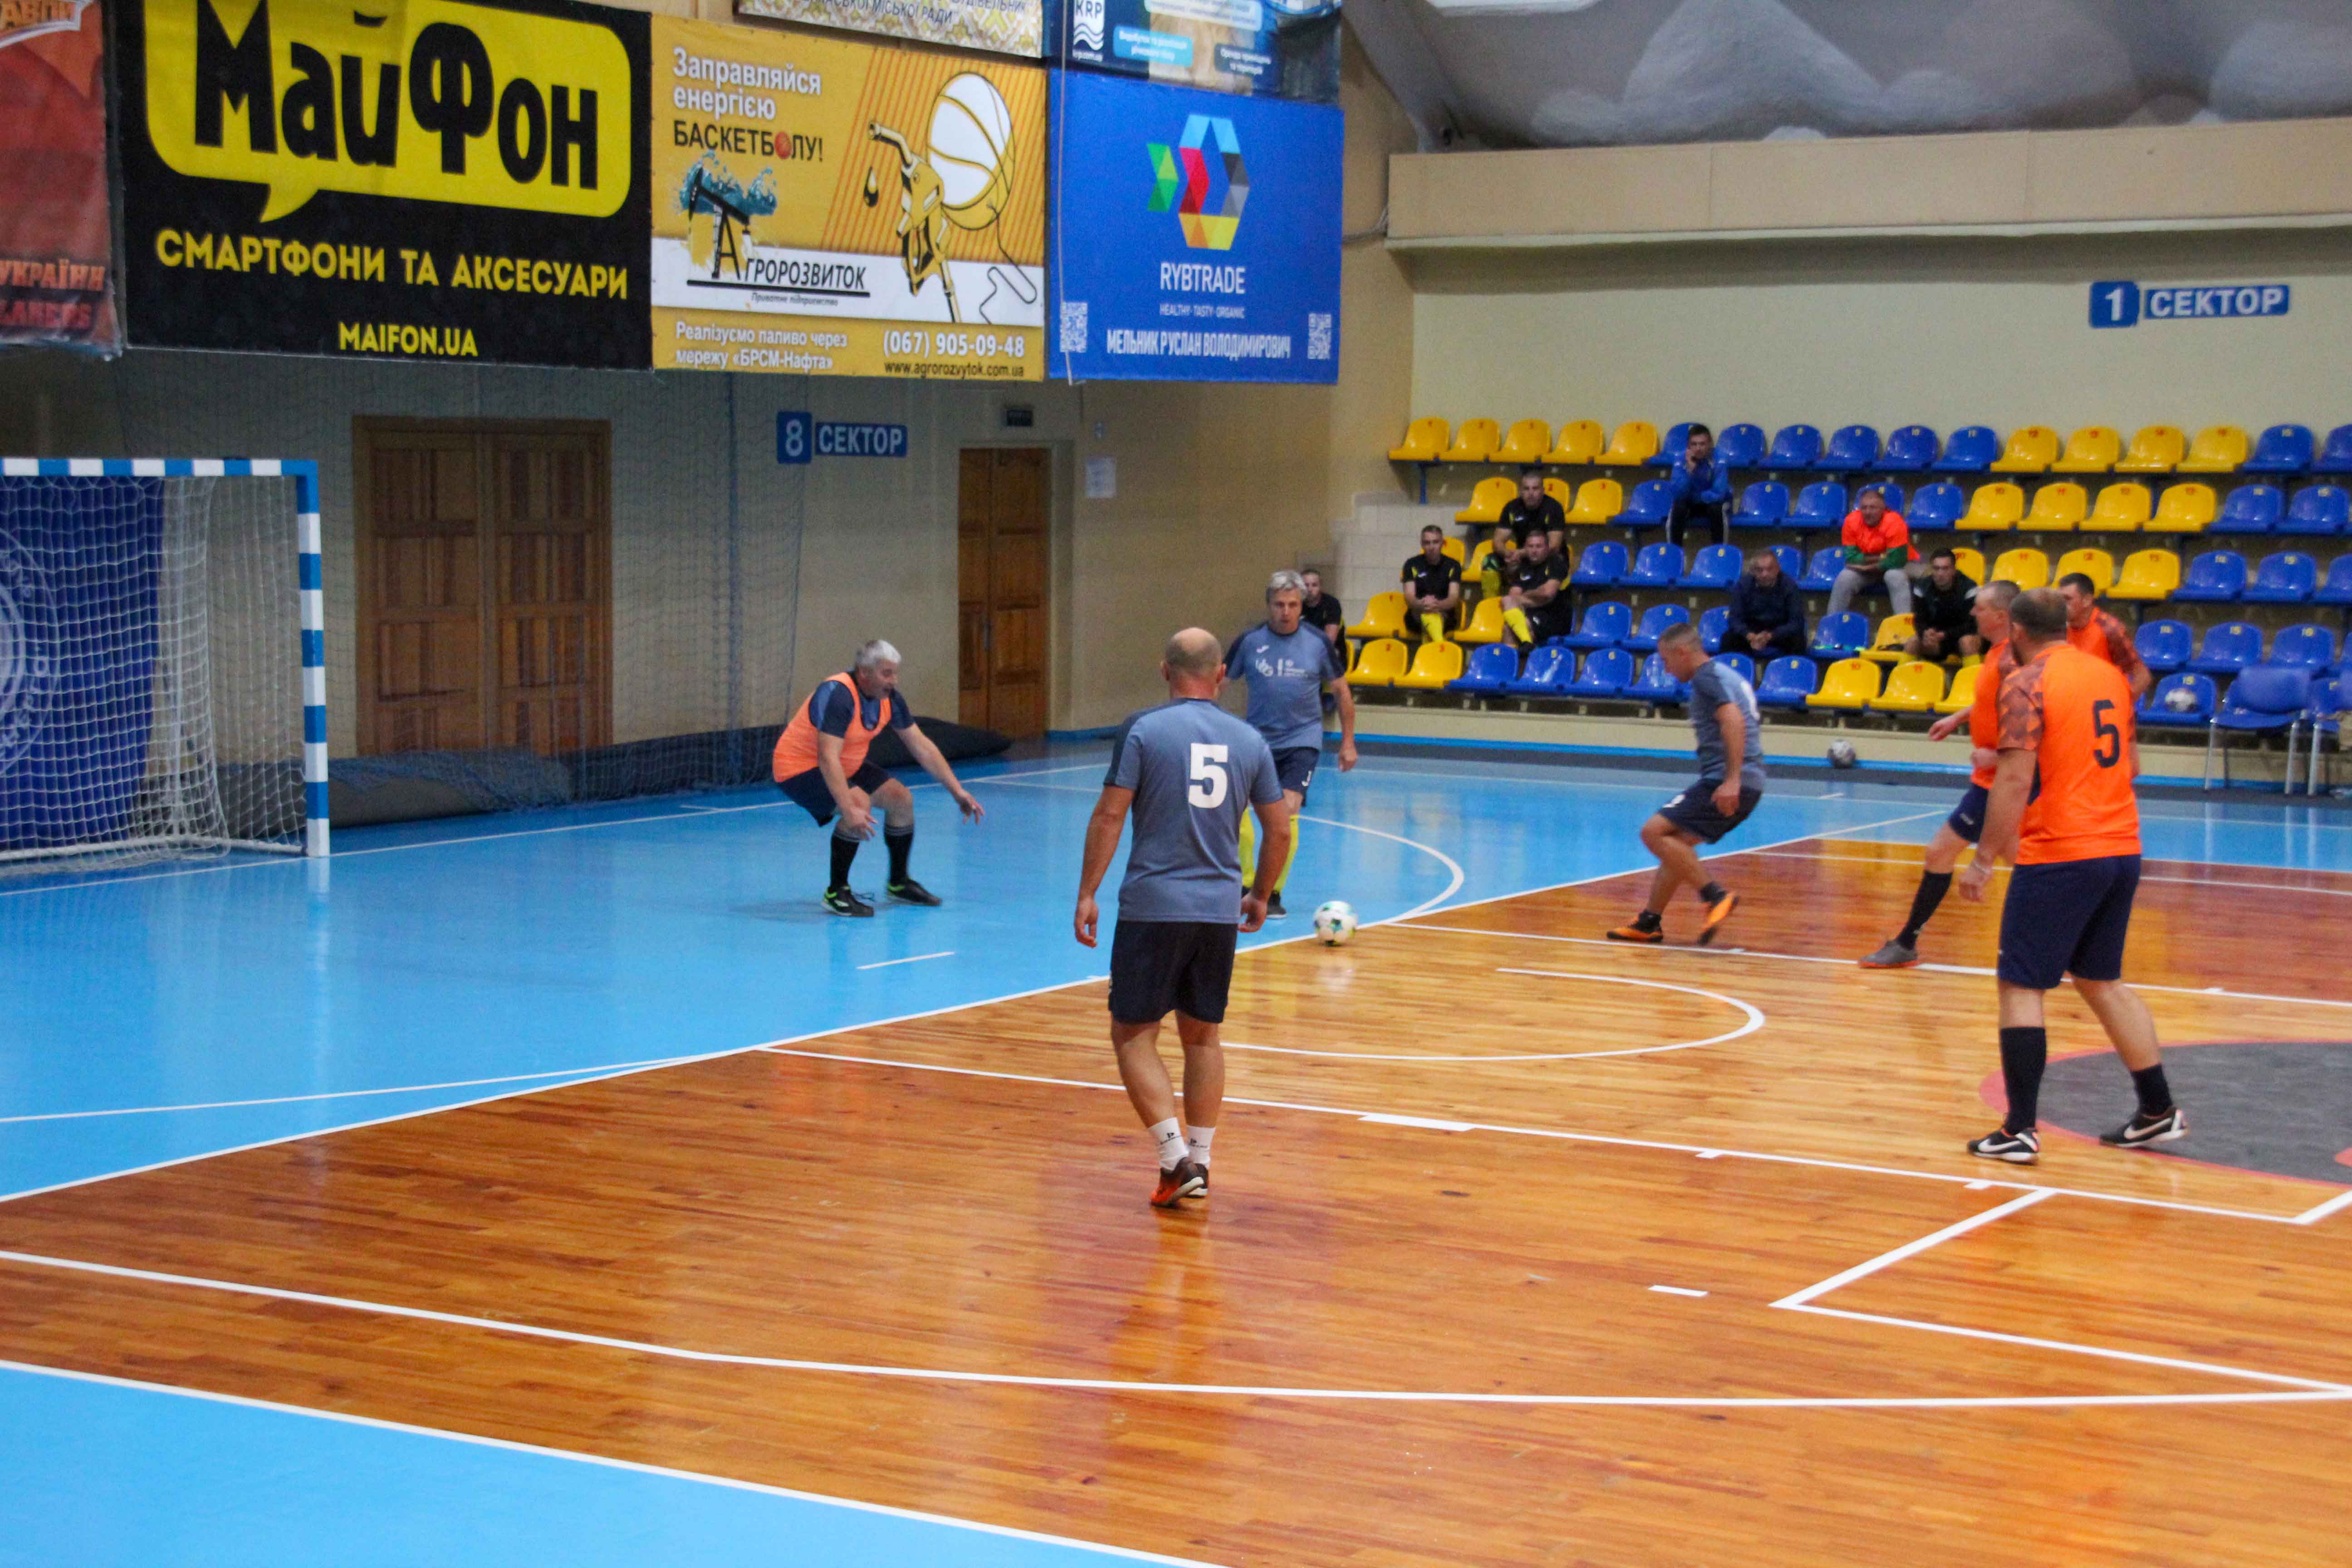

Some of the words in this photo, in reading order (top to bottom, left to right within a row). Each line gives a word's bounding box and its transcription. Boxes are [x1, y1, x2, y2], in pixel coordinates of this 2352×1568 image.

[1076, 0, 1102, 18] KRP
[673, 47, 822, 96] Заправляйся
[673, 86, 776, 120] енергією
[156, 229, 385, 283] СМАРТФОНИ
[399, 249, 439, 286] ТА
[451, 255, 628, 300] АКСЕСУАРИ
[1160, 262, 1246, 294] RYBTRADE
[2104, 288, 2123, 321] 1
[2150, 287, 2283, 317] СЕКТОР
[338, 322, 479, 357] MAIFON.UA
[676, 320, 755, 346] Реалізуємо
[759, 329, 807, 346] паливо
[810, 332, 848, 350] через
[883, 330, 930, 359] (067)
[936, 332, 1025, 358] 905-09-48
[1107, 328, 1159, 355] МЕЛЬНИК
[1160, 331, 1202, 356] РУСЛАН
[1203, 333, 1291, 362] ВОЛОДИМИРОВИЧ
[676, 350, 729, 370] мережу
[885, 362, 1024, 380] www.agrorozvytok.com.ua
[785, 419, 804, 457] 8
[818, 425, 903, 455] СЕКТОР
[1822, 486, 1828, 495] 7
[2092, 699, 2120, 768] 5
[1188, 743, 1228, 809] 5
